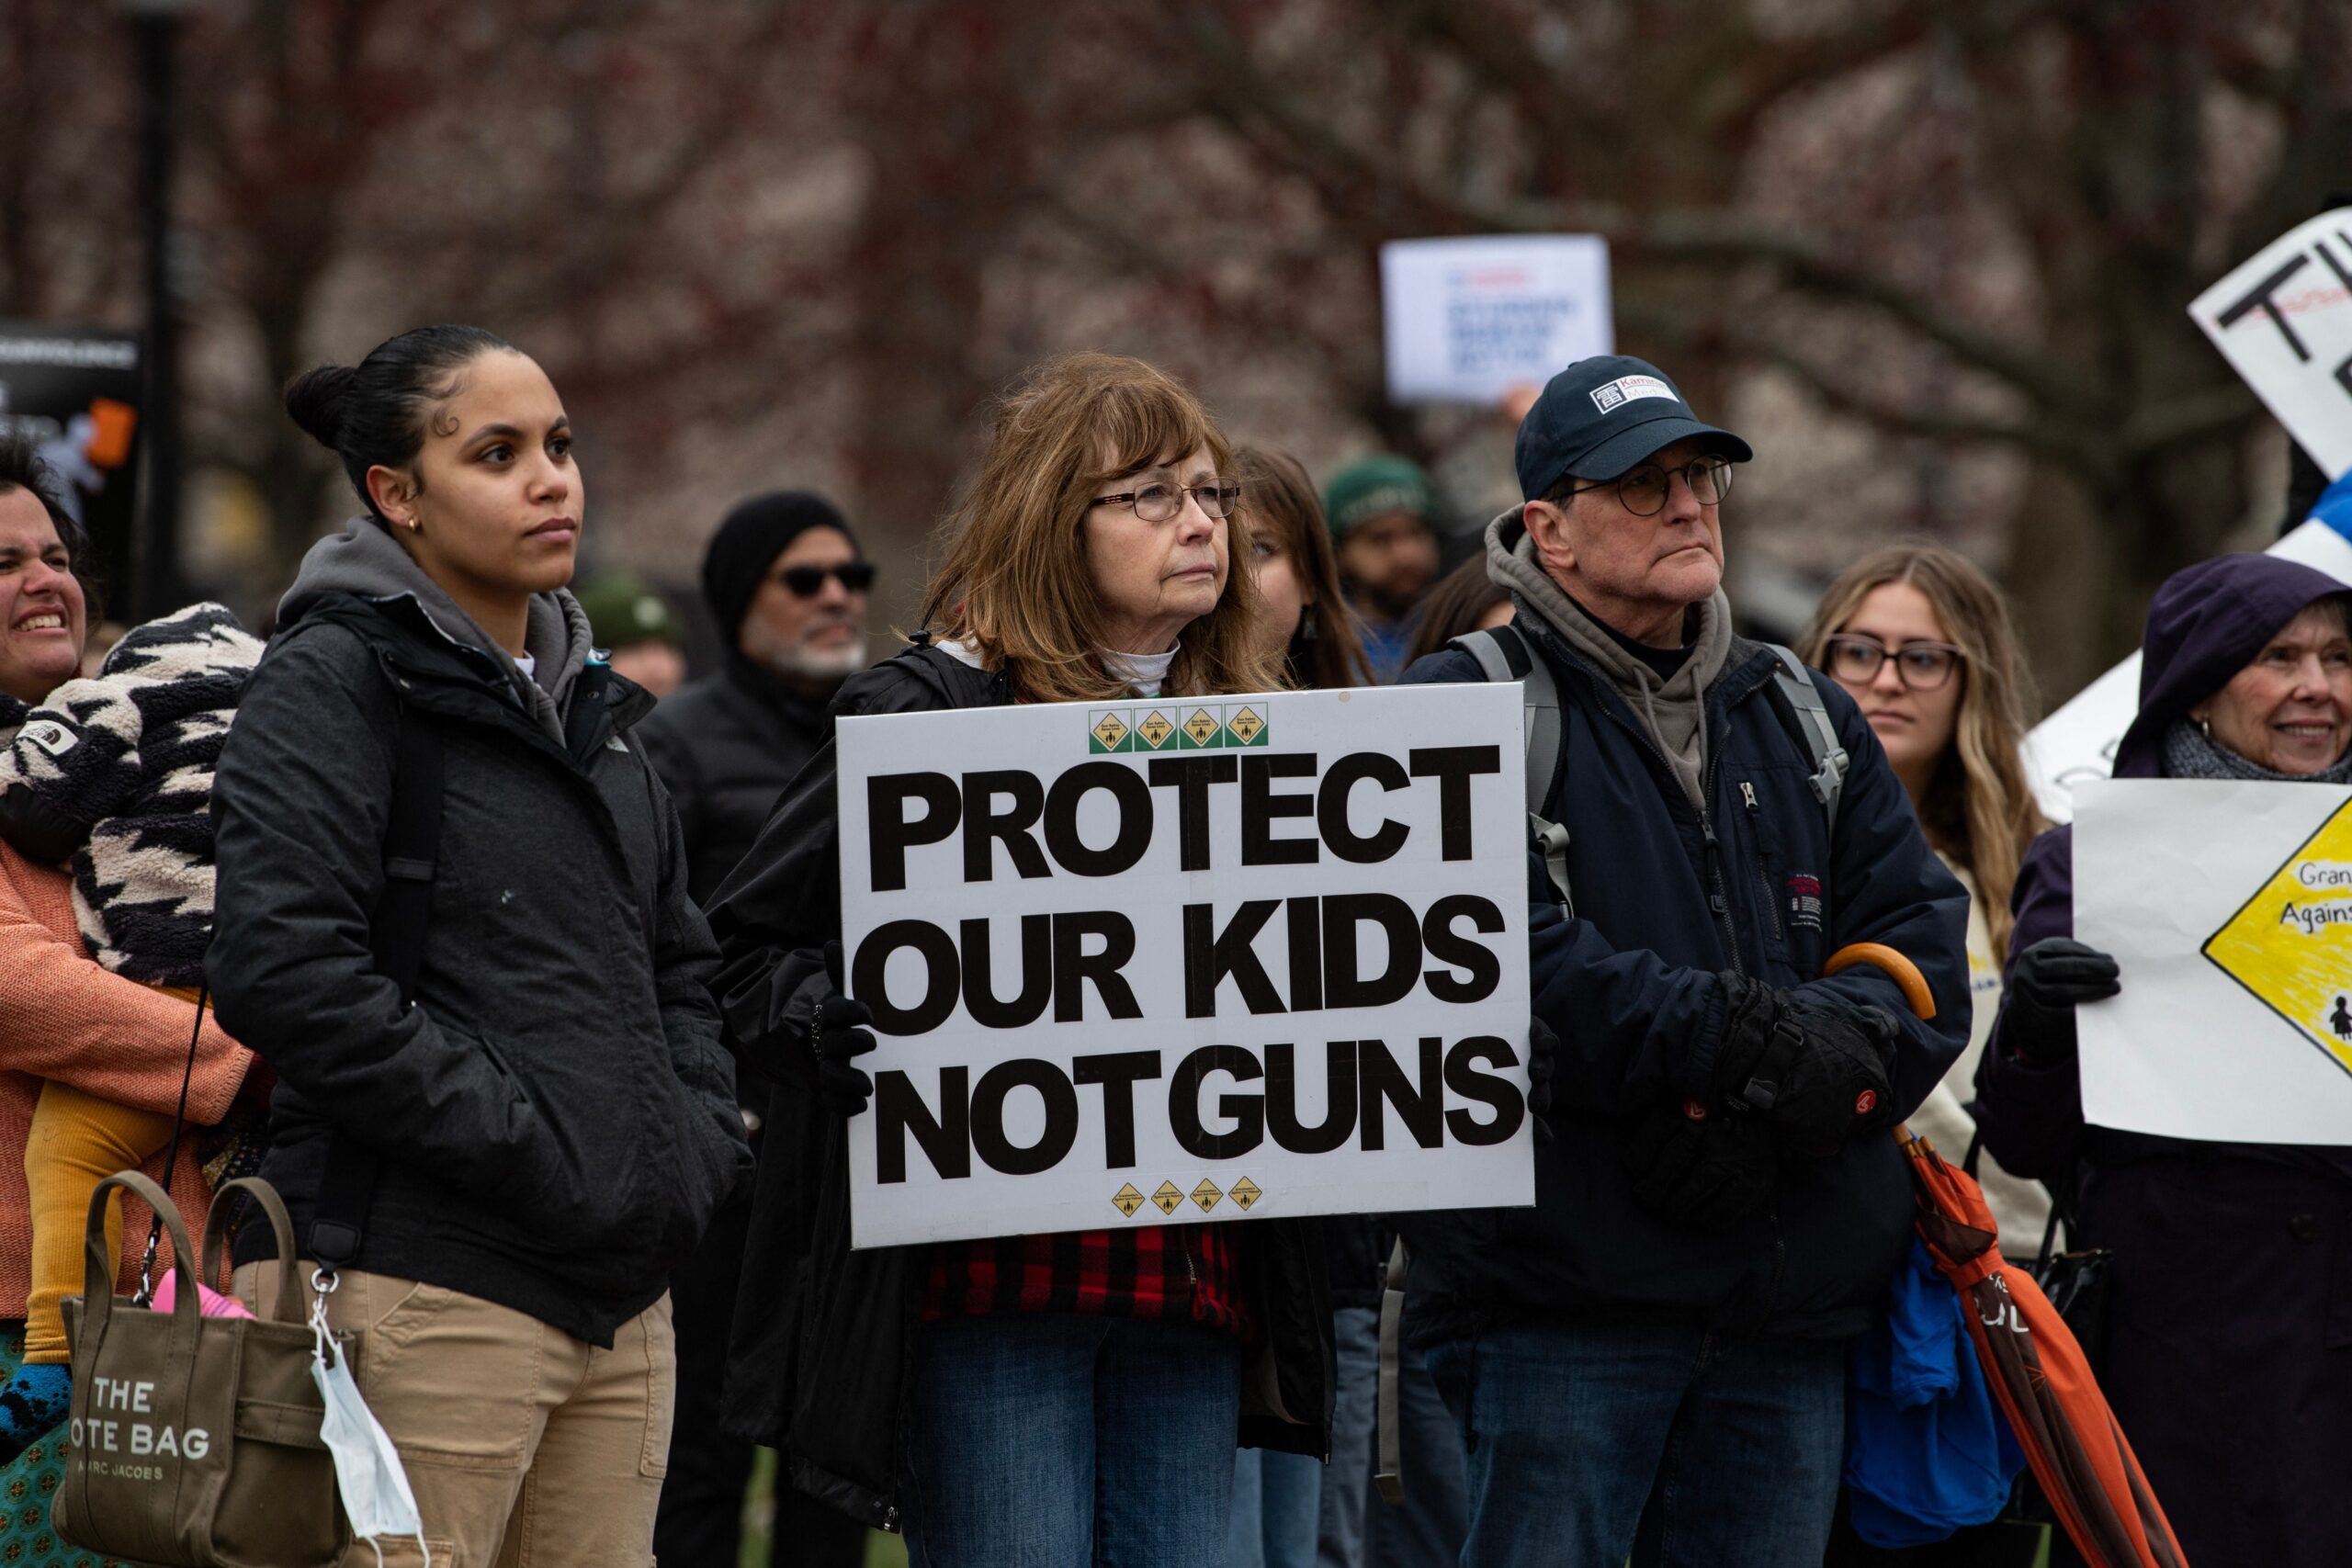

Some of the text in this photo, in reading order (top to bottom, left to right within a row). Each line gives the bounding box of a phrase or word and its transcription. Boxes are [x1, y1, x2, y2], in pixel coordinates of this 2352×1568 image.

[867, 745, 1500, 892] PROTECT
[2300, 862, 2352, 886] Gran
[852, 894, 1506, 1036] OUR KIDS
[875, 1035, 1525, 1185] NOT GUNS
[94, 1377, 154, 1413] THE
[130, 1424, 209, 1461] BAG
[111, 1464, 163, 1481] JACOBS
